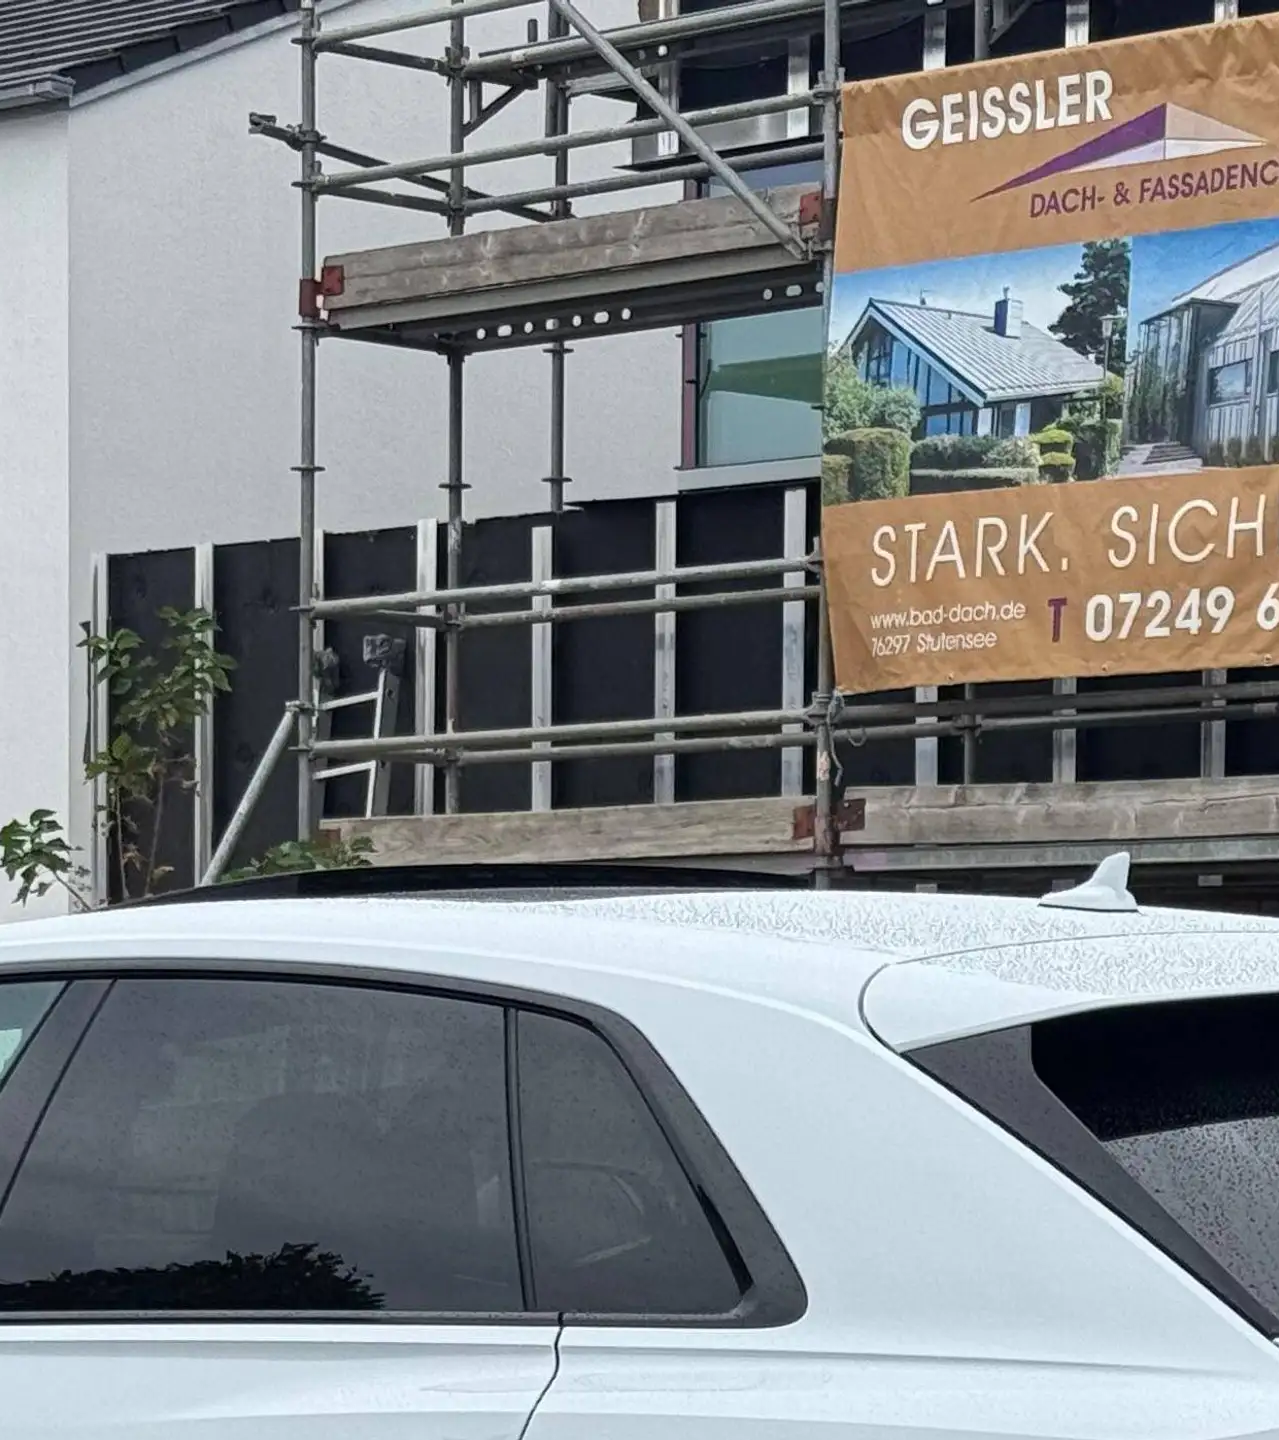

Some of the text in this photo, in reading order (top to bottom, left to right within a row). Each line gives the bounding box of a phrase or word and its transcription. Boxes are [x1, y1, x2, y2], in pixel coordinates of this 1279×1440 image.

[901, 70, 1113, 150] GEISSLER
[1030, 184, 1105, 218] DACH-
[1113, 181, 1131, 207] &
[870, 512, 1069, 588] STARK.
[870, 601, 1027, 629] www.bad-dach.de
[1048, 597, 1068, 642] T
[1085, 586, 1236, 642] 07249
[871, 631, 998, 658] 76297 Stutensee
